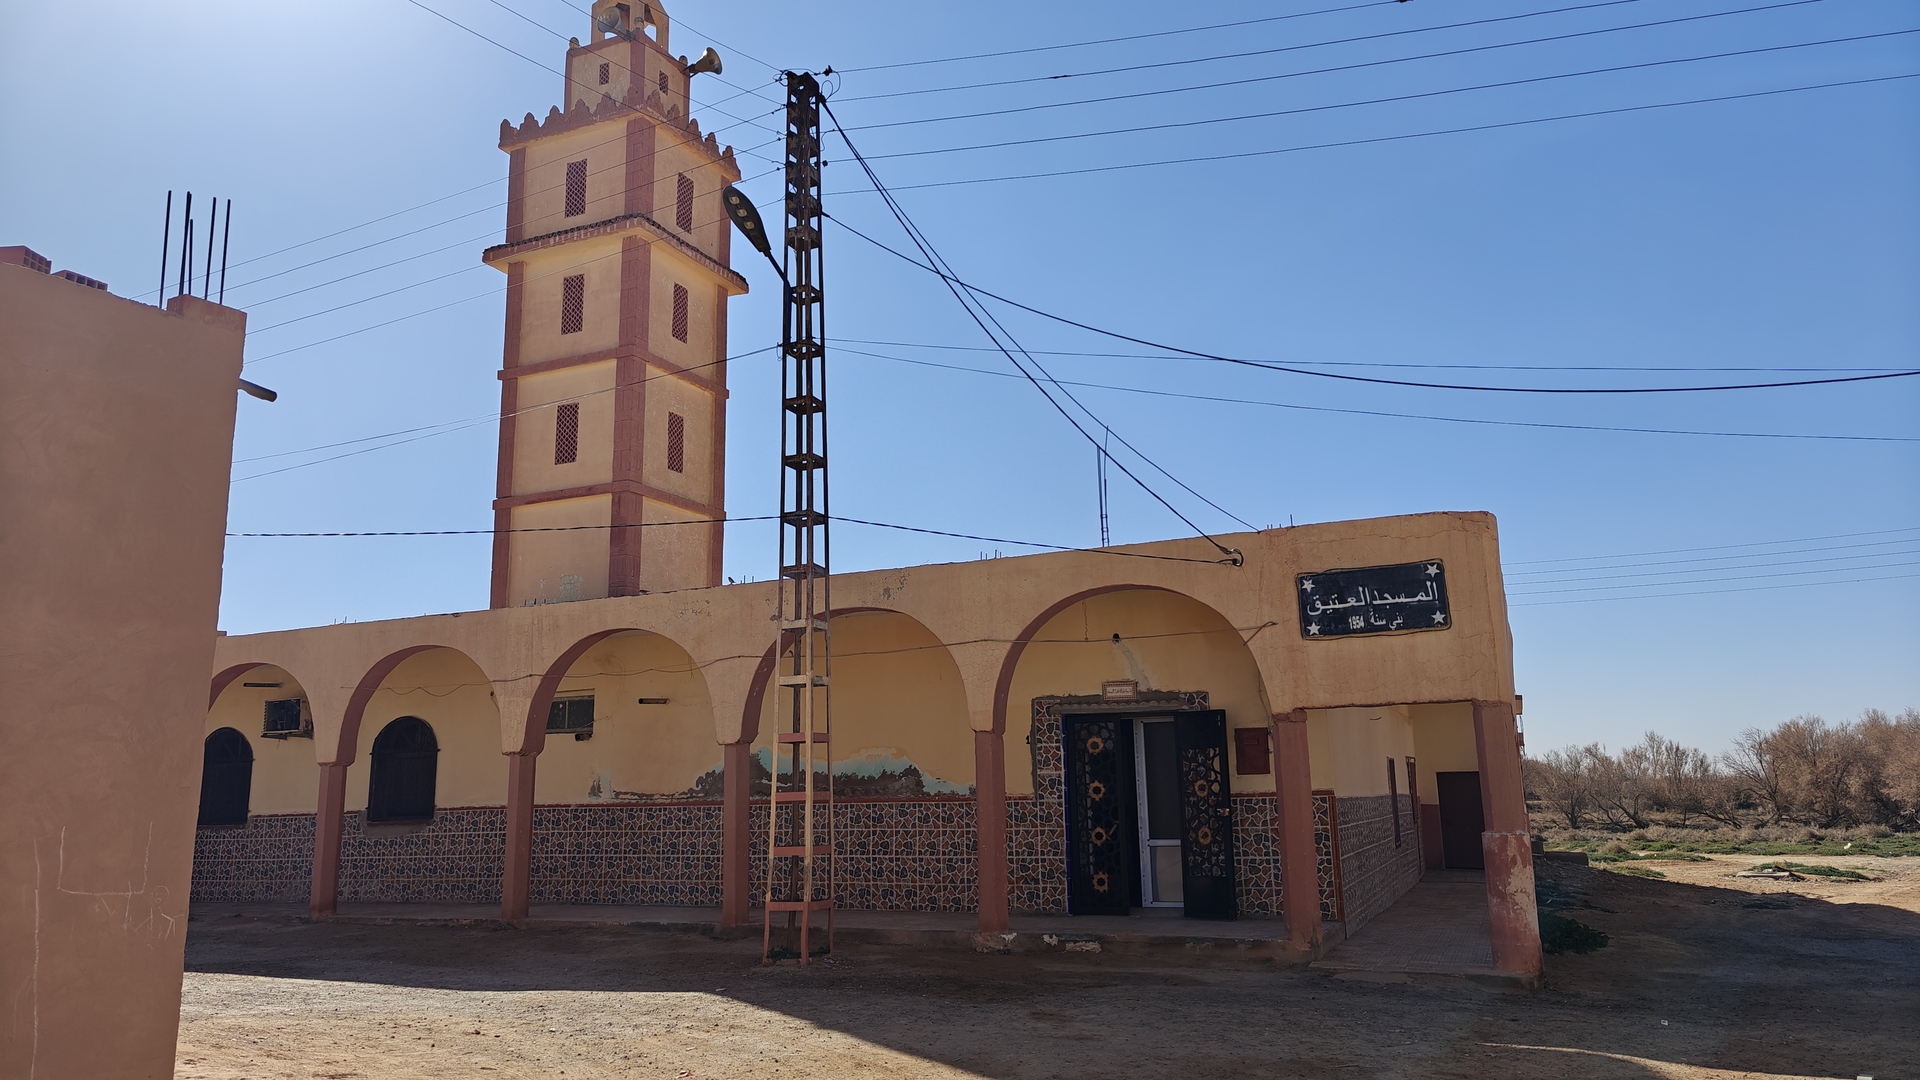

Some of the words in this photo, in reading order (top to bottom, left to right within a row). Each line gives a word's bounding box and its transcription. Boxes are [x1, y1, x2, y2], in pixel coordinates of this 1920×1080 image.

[1307, 586, 1371, 616] العتيق
[1372, 581, 1438, 609] المسجد
[1348, 615, 1365, 630] 1954
[1369, 611, 1387, 626] سنة
